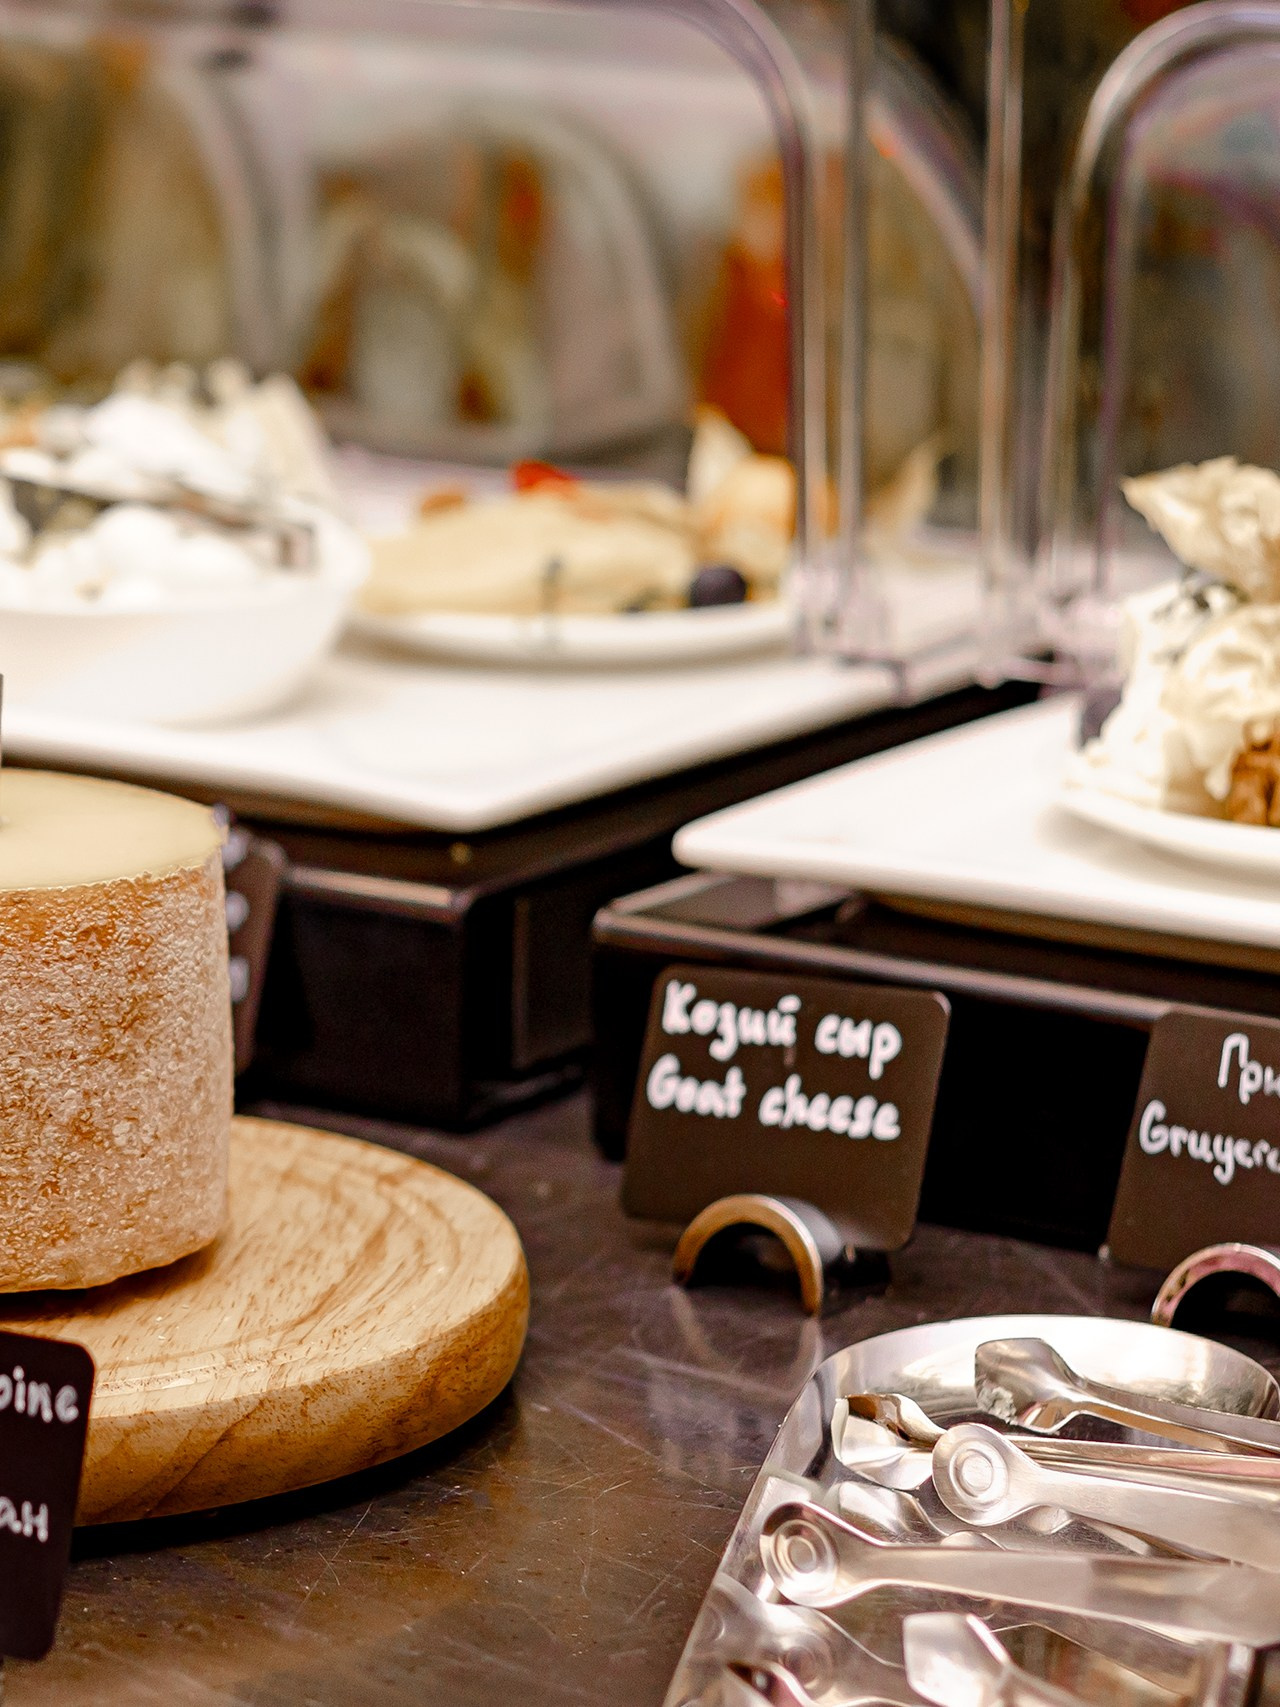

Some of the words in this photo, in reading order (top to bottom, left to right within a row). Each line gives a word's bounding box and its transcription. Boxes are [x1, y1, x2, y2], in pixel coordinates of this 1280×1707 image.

[661, 979, 802, 1062] Козий
[646, 1053, 747, 1119] Goat
[758, 1073, 901, 1141] cheese
